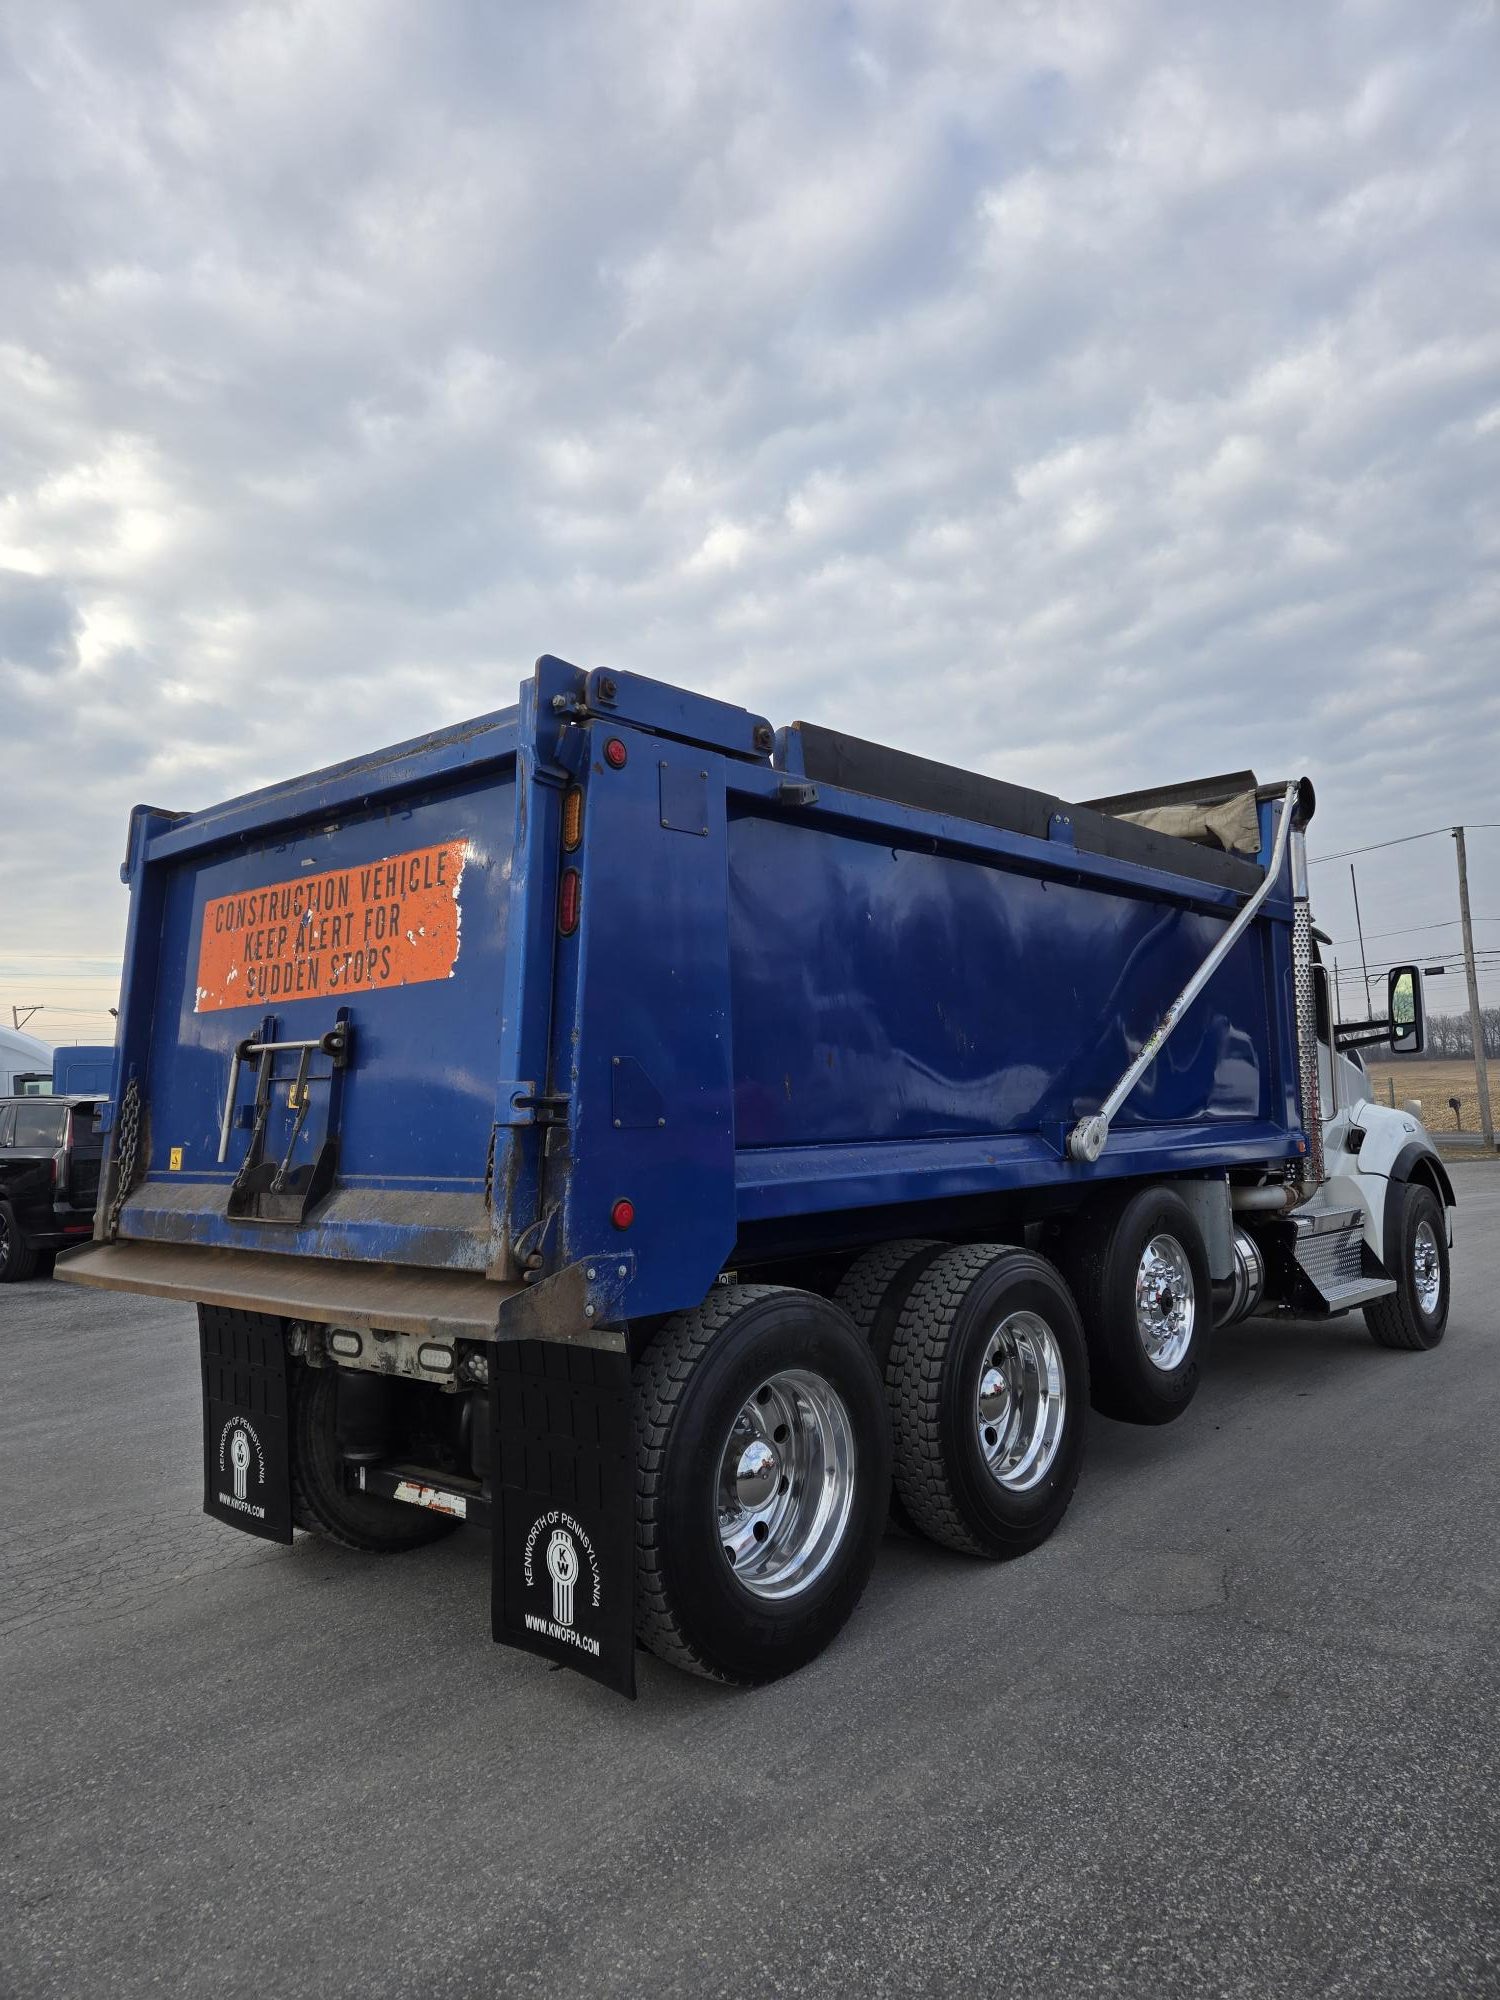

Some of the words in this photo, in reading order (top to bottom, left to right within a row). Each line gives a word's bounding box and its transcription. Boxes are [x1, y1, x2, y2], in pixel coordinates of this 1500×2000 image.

[215, 874, 350, 933] CONSTRUCTION
[361, 851, 448, 903] VEHICLE
[243, 925, 287, 962] KEEP
[295, 912, 354, 957] ALERT
[364, 903, 401, 942] FOR
[246, 958, 319, 999] SUDDEN
[330, 945, 391, 987] STOPS
[240, 1417, 265, 1484] PENNSYLVANIA
[218, 1492, 265, 1519] WWW.KWOFPA.COM
[524, 1515, 547, 1587] KENWORTH
[547, 1511, 559, 1524] OF
[561, 1512, 601, 1607] PENNSYLVANIA
[524, 1613, 600, 1656] WWW.KWOFPA.COM
